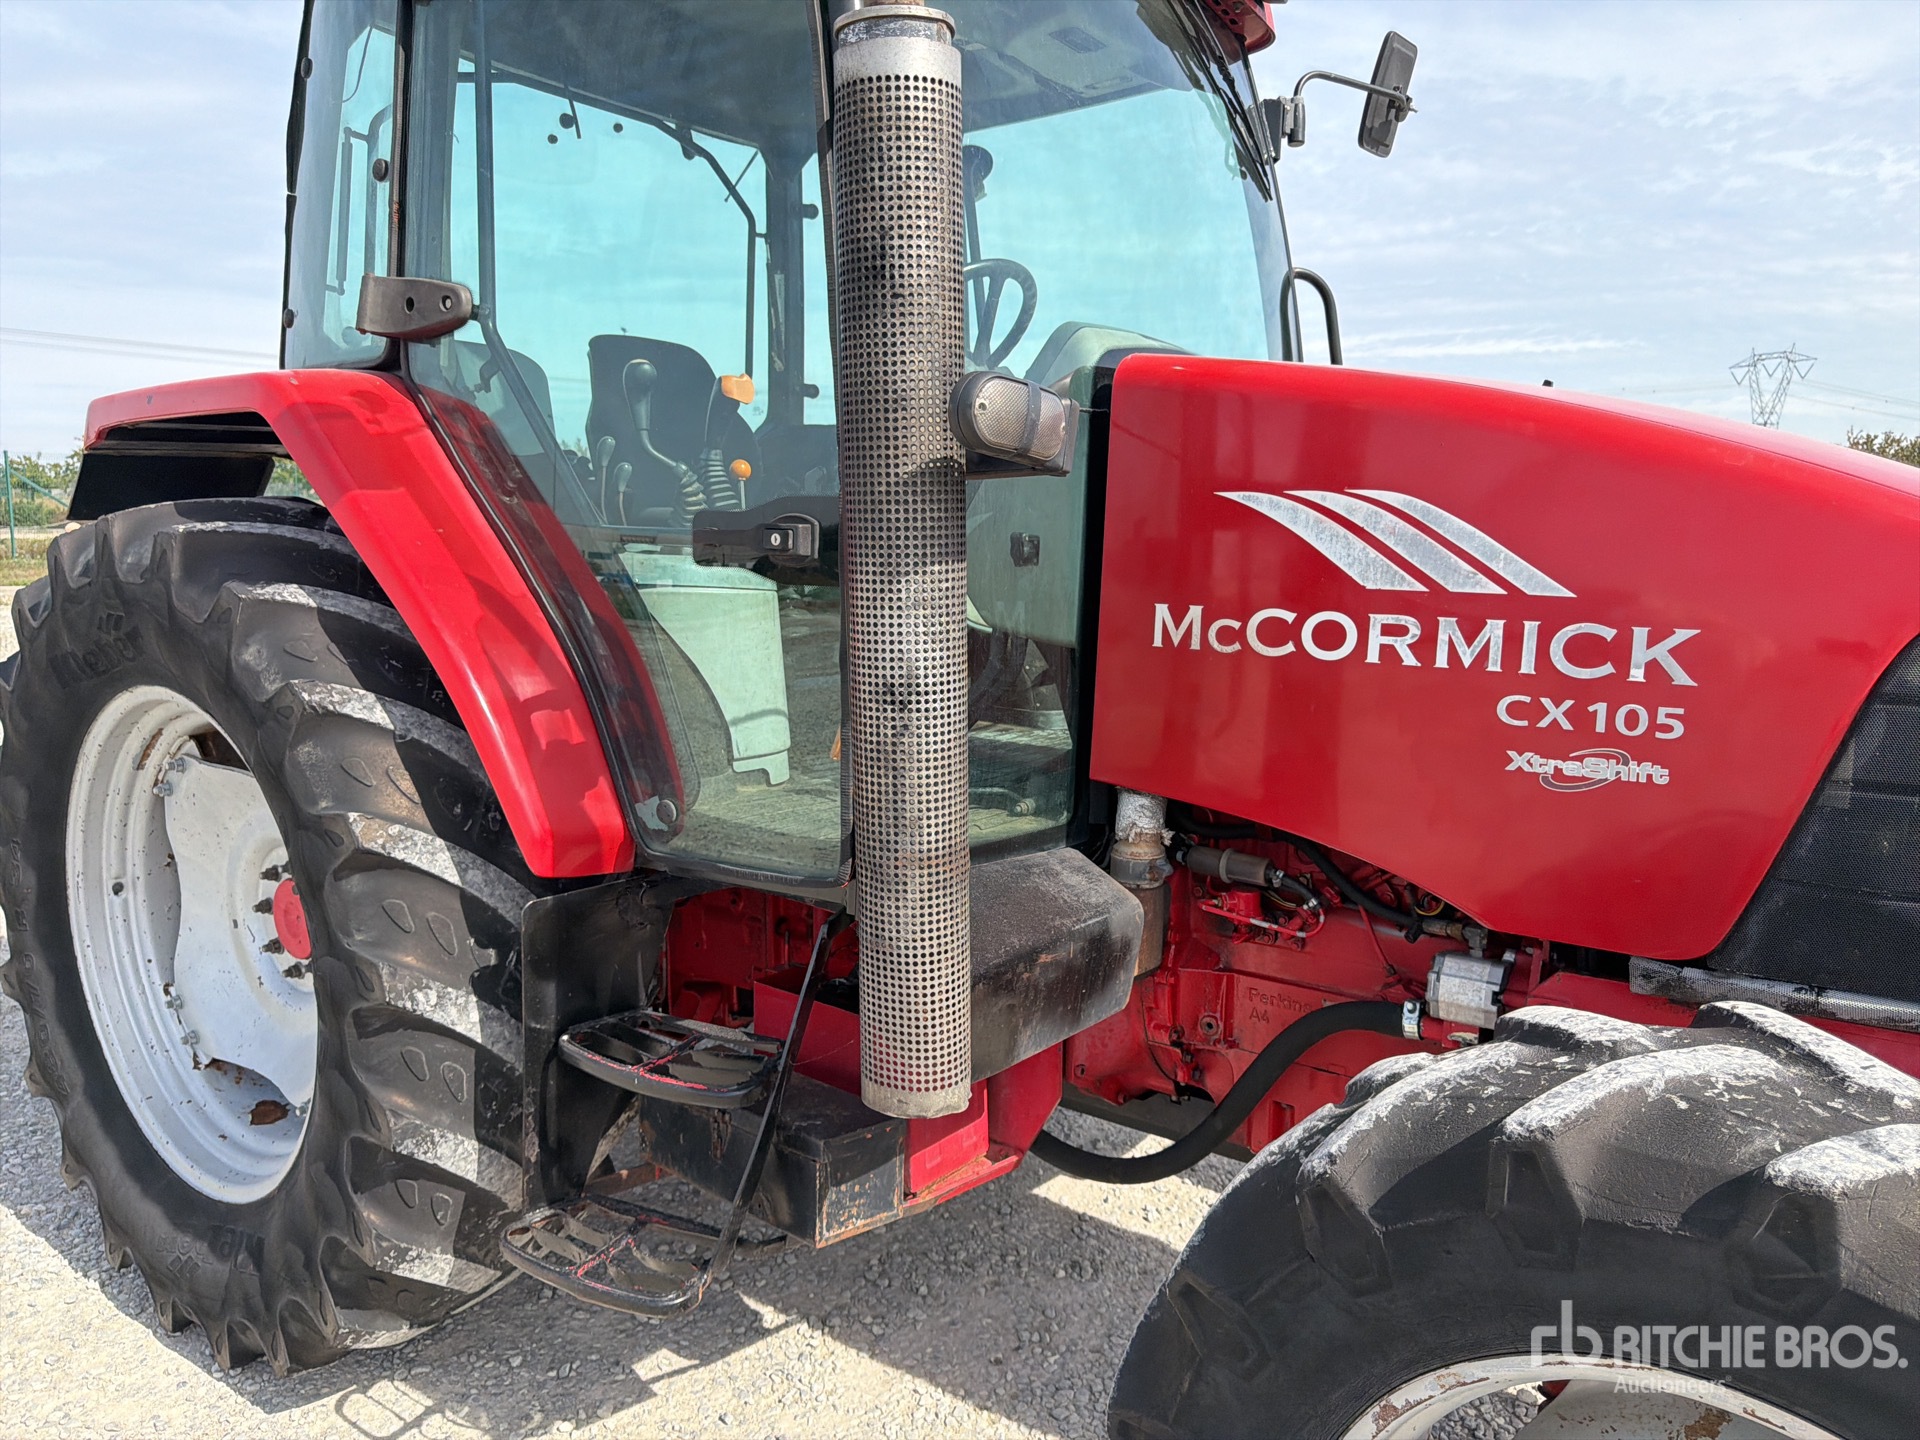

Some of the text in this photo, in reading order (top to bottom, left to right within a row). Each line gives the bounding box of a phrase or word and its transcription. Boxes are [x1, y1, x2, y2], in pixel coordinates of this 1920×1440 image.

[1152, 602, 1701, 687] McCORMICK
[1496, 694, 1687, 741] CX 105
[1505, 750, 1671, 788] XtraShift
